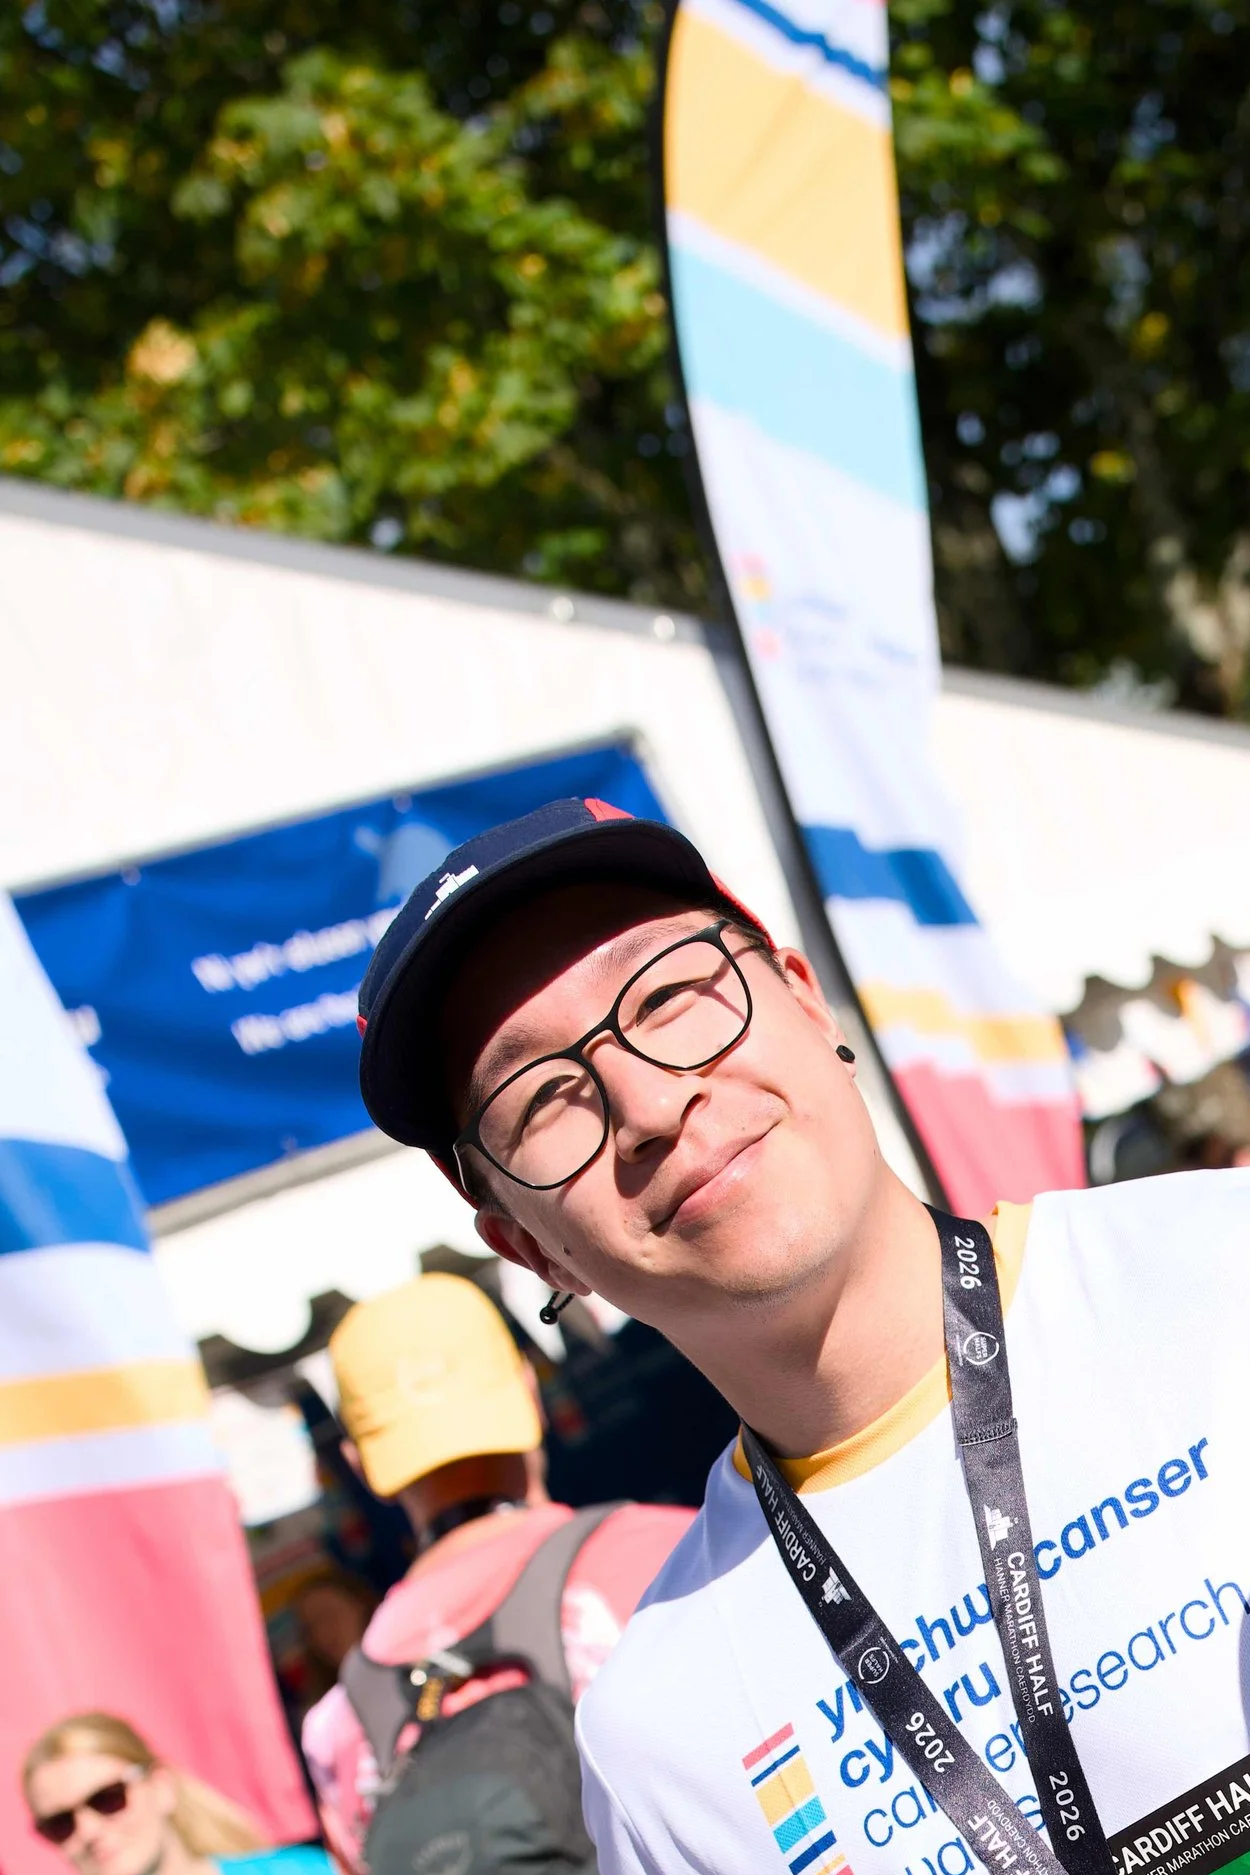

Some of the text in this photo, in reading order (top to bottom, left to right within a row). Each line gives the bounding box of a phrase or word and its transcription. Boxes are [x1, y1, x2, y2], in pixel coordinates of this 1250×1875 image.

[954, 1235, 982, 1290] 2026
[755, 1464, 779, 1513] HALF
[1033, 1437, 1208, 1580] canser
[774, 1511, 817, 1582] CARDIFF
[801, 1531, 826, 1566] HANNER
[994, 1557, 1036, 1724] HANNER MARATHON CAERDYDD
[1007, 1551, 1054, 1717] CARDIFF HALF
[840, 1661, 1001, 1788] cyru
[905, 1711, 956, 1774] 2026
[987, 1800, 1026, 1847] CAERDYDD
[1048, 1771, 1086, 1841] 2026
[967, 1813, 1018, 1869] HALF
[1165, 1828, 1231, 1874] MARATHON
